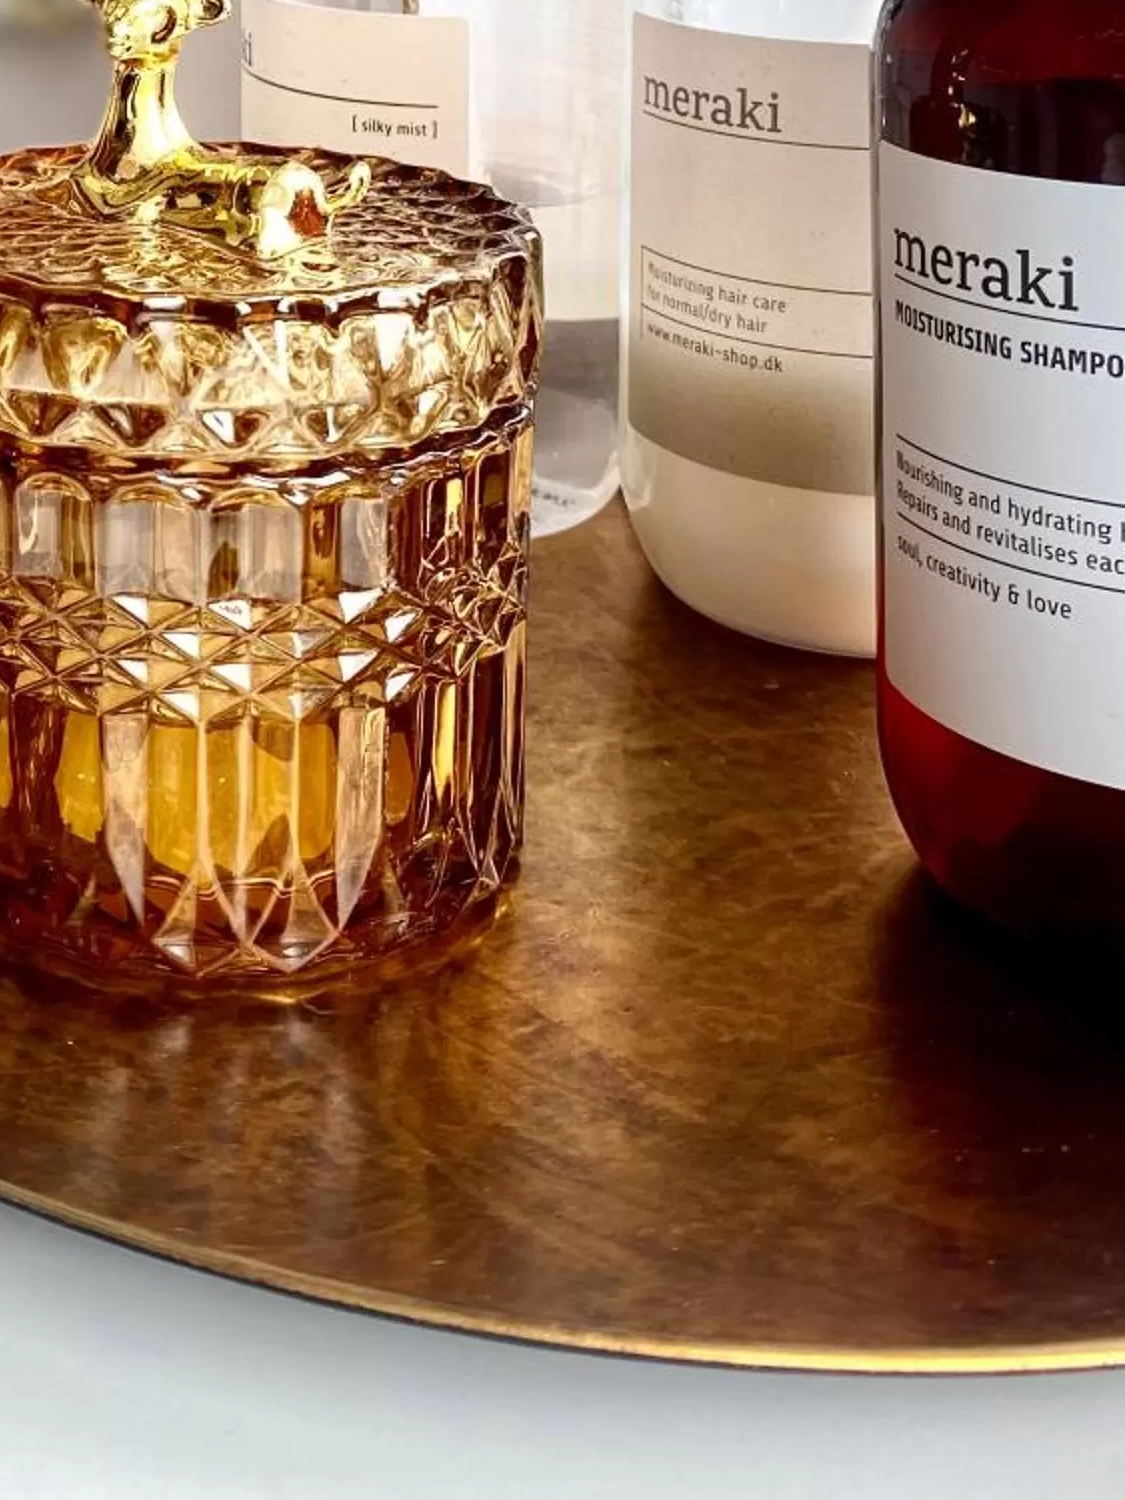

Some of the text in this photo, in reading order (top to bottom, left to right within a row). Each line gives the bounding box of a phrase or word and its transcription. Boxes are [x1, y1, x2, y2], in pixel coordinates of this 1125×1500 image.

[361, 117, 393, 137] silky
[396, 122, 427, 137] mist
[643, 75, 782, 132] meraki
[718, 284, 748, 305] hair
[752, 296, 786, 313] care
[894, 227, 1079, 311] meraki
[662, 293, 732, 329] normal/dry
[736, 311, 768, 333] hair
[895, 299, 1124, 378] MOISTURISING SHAMPO
[647, 323, 784, 373] www.meraki-shop.dk
[896, 449, 964, 506] Nourishing
[968, 490, 1001, 515] and
[1007, 497, 1113, 545] hydrating
[897, 479, 1125, 576] Repairs and revitalises eac
[926, 554, 1001, 603] creativity
[1007, 583, 1020, 605] &
[1026, 588, 1072, 619] love
